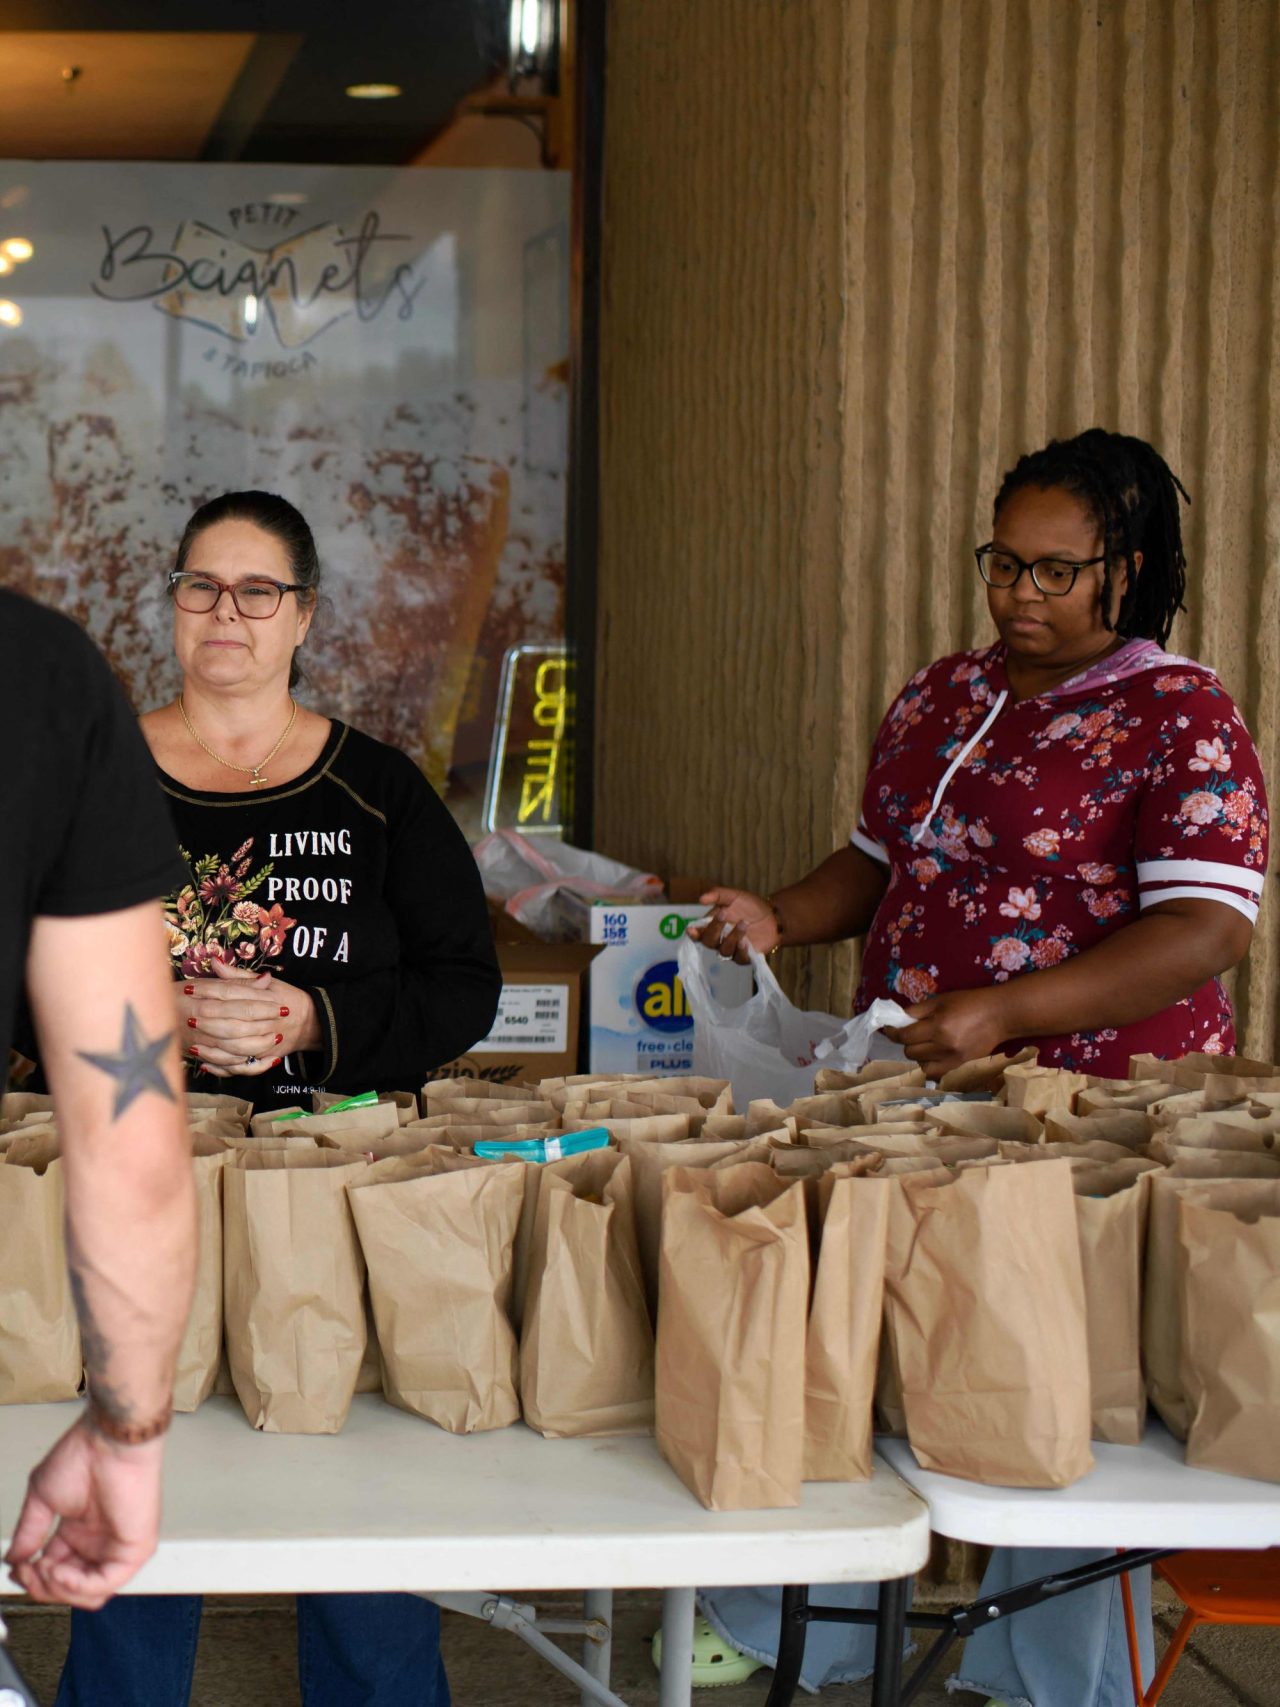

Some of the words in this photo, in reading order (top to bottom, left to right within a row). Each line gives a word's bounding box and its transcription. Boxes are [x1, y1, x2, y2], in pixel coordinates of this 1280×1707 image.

[228, 203, 301, 228] PETIT
[222, 350, 318, 379] TAPIOCA
[269, 829, 352, 857] LIVING
[267, 877, 352, 905] PROOF
[603, 913, 628, 927] 160
[293, 926, 327, 959] OF
[333, 931, 350, 963] A
[504, 1015, 528, 1025] 6540
[637, 1039, 665, 1052] free
[650, 1059, 692, 1070] PLUS
[276, 1085, 301, 1094] JOHN
